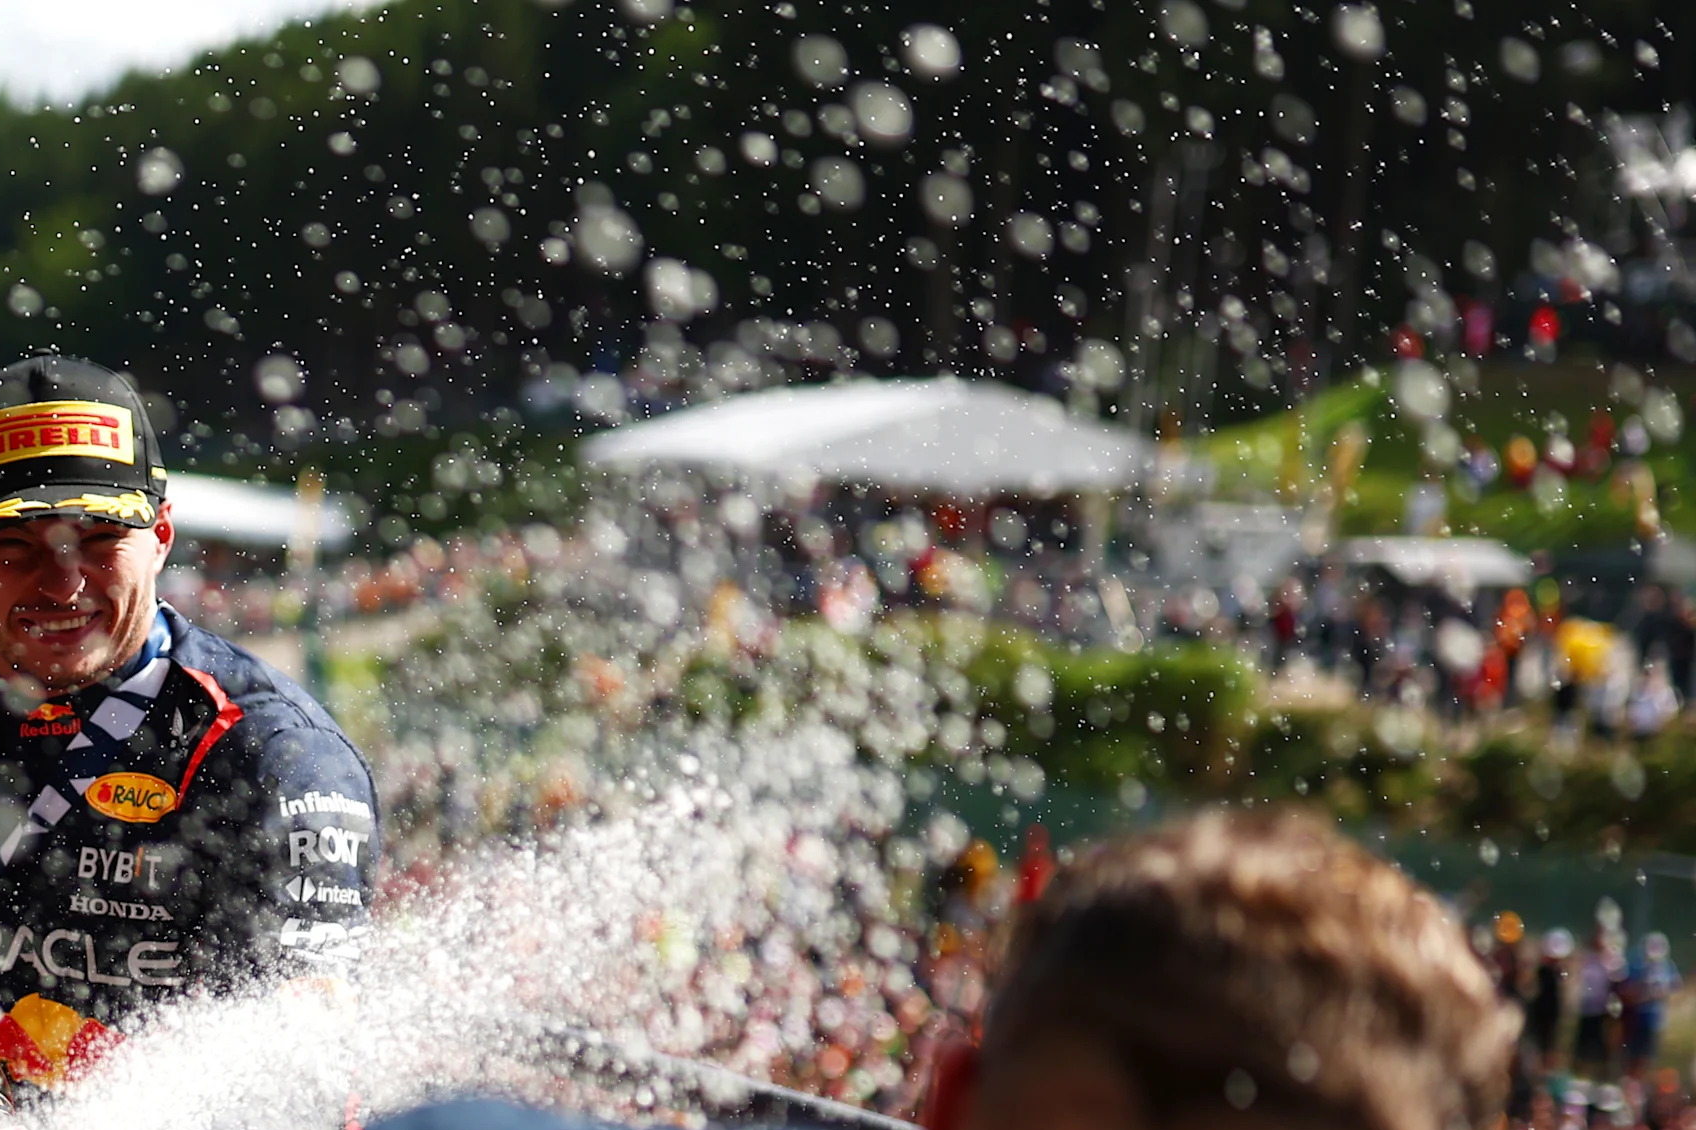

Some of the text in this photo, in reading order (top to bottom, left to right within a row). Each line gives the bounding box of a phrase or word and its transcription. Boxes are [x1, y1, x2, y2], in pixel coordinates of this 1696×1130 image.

[19, 718, 83, 739] Red Bull
[112, 784, 166, 811] RAUC
[77, 845, 163, 891] BYBIT
[68, 893, 175, 922] HONDA
